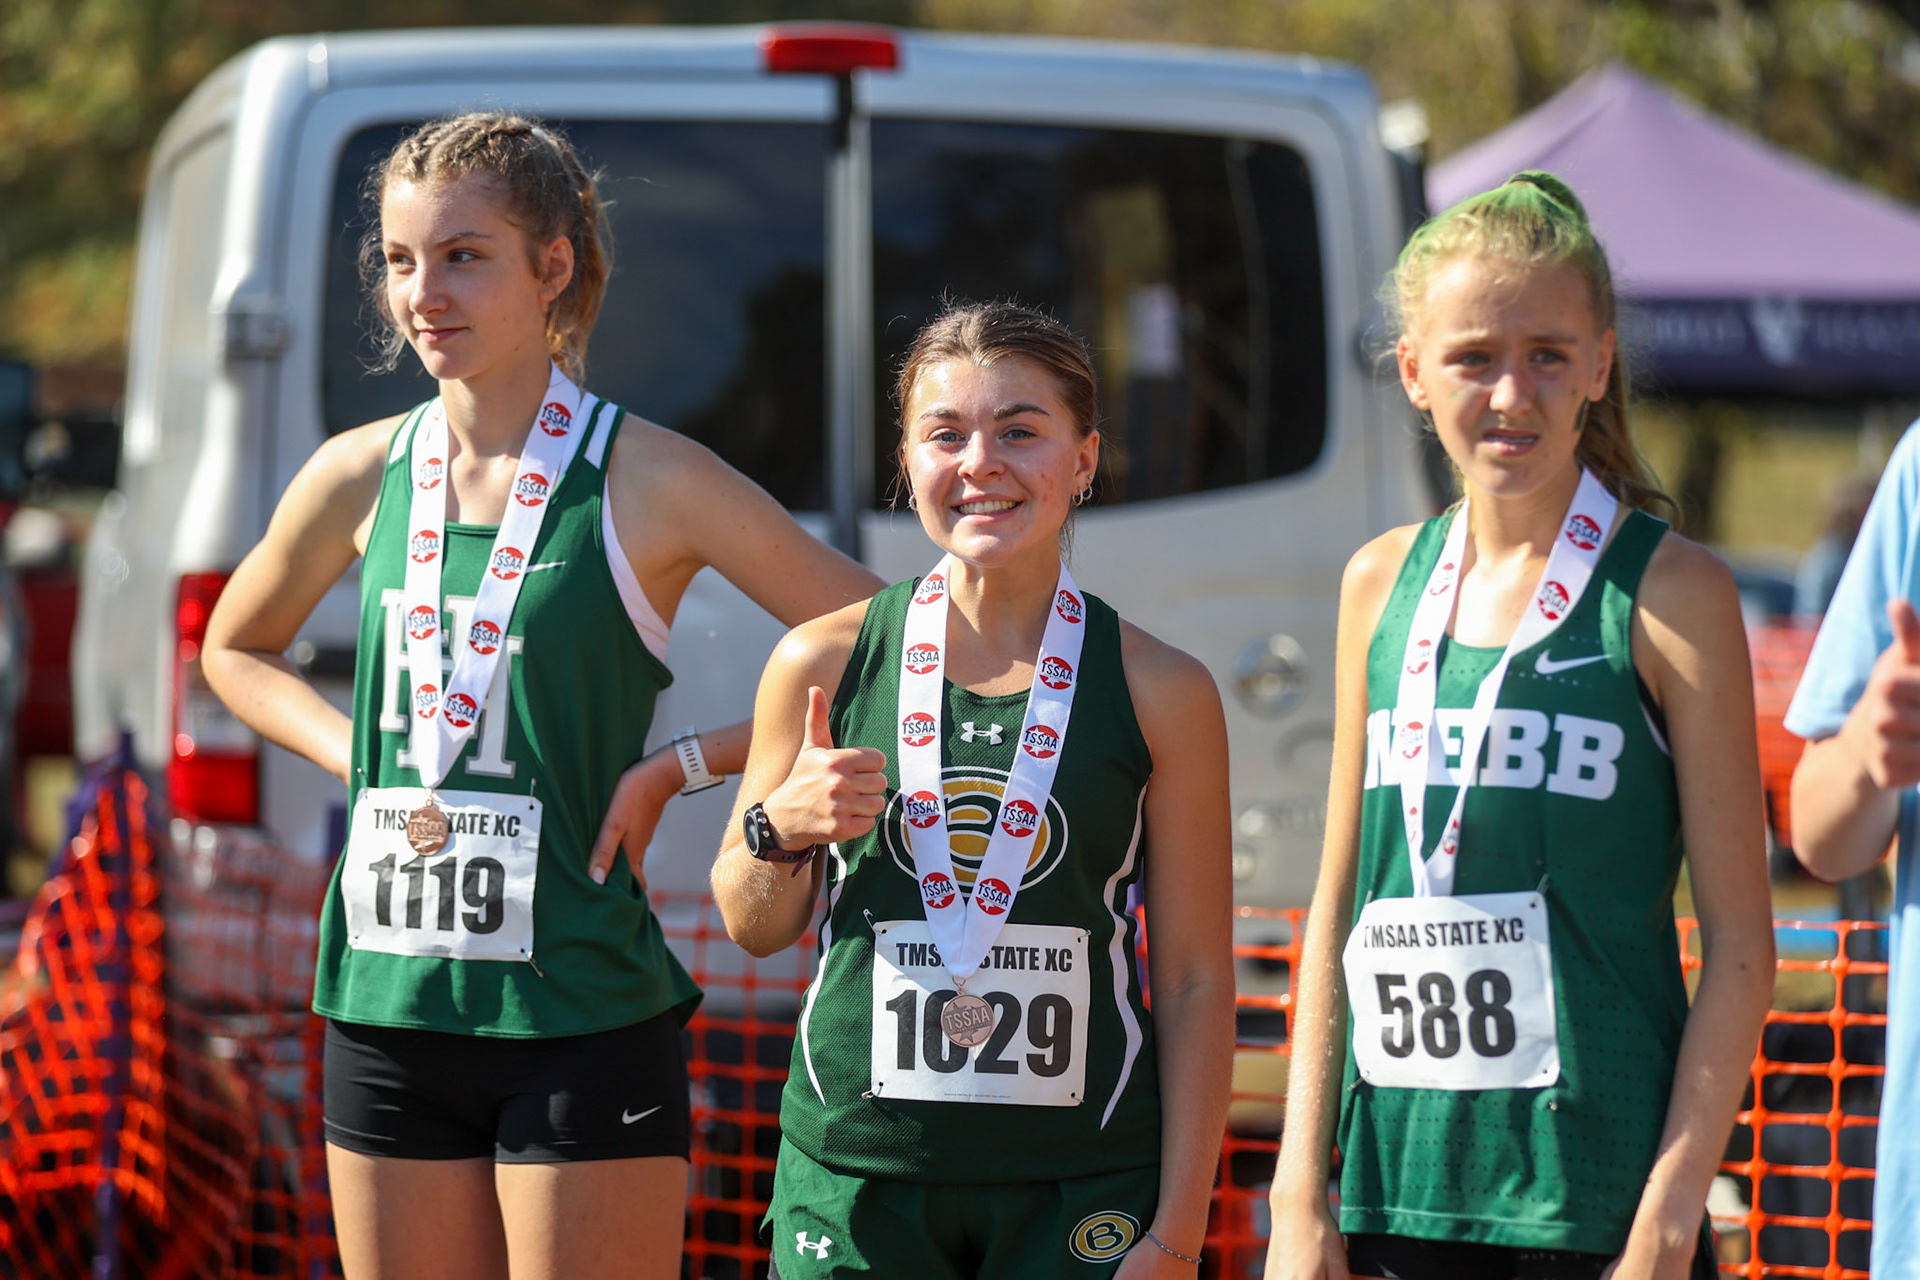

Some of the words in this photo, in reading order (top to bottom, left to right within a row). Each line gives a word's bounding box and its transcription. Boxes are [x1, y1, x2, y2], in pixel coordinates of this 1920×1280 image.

[542, 406, 570, 429] TSSAA
[517, 479, 548, 497] TSSAA
[1568, 517, 1602, 544] TSSAA
[412, 538, 440, 553] TSSAA
[493, 553, 523, 571] TSSAA
[1057, 592, 1082, 618] TSSAA
[408, 613, 437, 629] TSSAA
[471, 626, 500, 646] TSSAA
[907, 651, 940, 664] TSSAA
[1041, 659, 1073, 682] TSSAA
[446, 697, 476, 721] TSSAA
[902, 721, 936, 735] TSSAA
[1025, 730, 1058, 750] TSSAA
[906, 799, 941, 816] TSSAA
[1003, 806, 1036, 827] TSSAA
[446, 812, 489, 836] TATE
[493, 814, 521, 838] XC
[368, 853, 506, 935] 1119
[922, 880, 954, 898] TSSAA
[978, 883, 1010, 907] TSSAA
[1363, 924, 1421, 949] TMSAA
[1424, 919, 1489, 947] STATE
[1494, 917, 1524, 944] XC
[1044, 948, 1073, 973] XC
[945, 1007, 991, 1030] TSSAA
[1374, 968, 1516, 1059] 588
[885, 989, 1074, 1078] 1029
[1084, 1220, 1126, 1253] B
